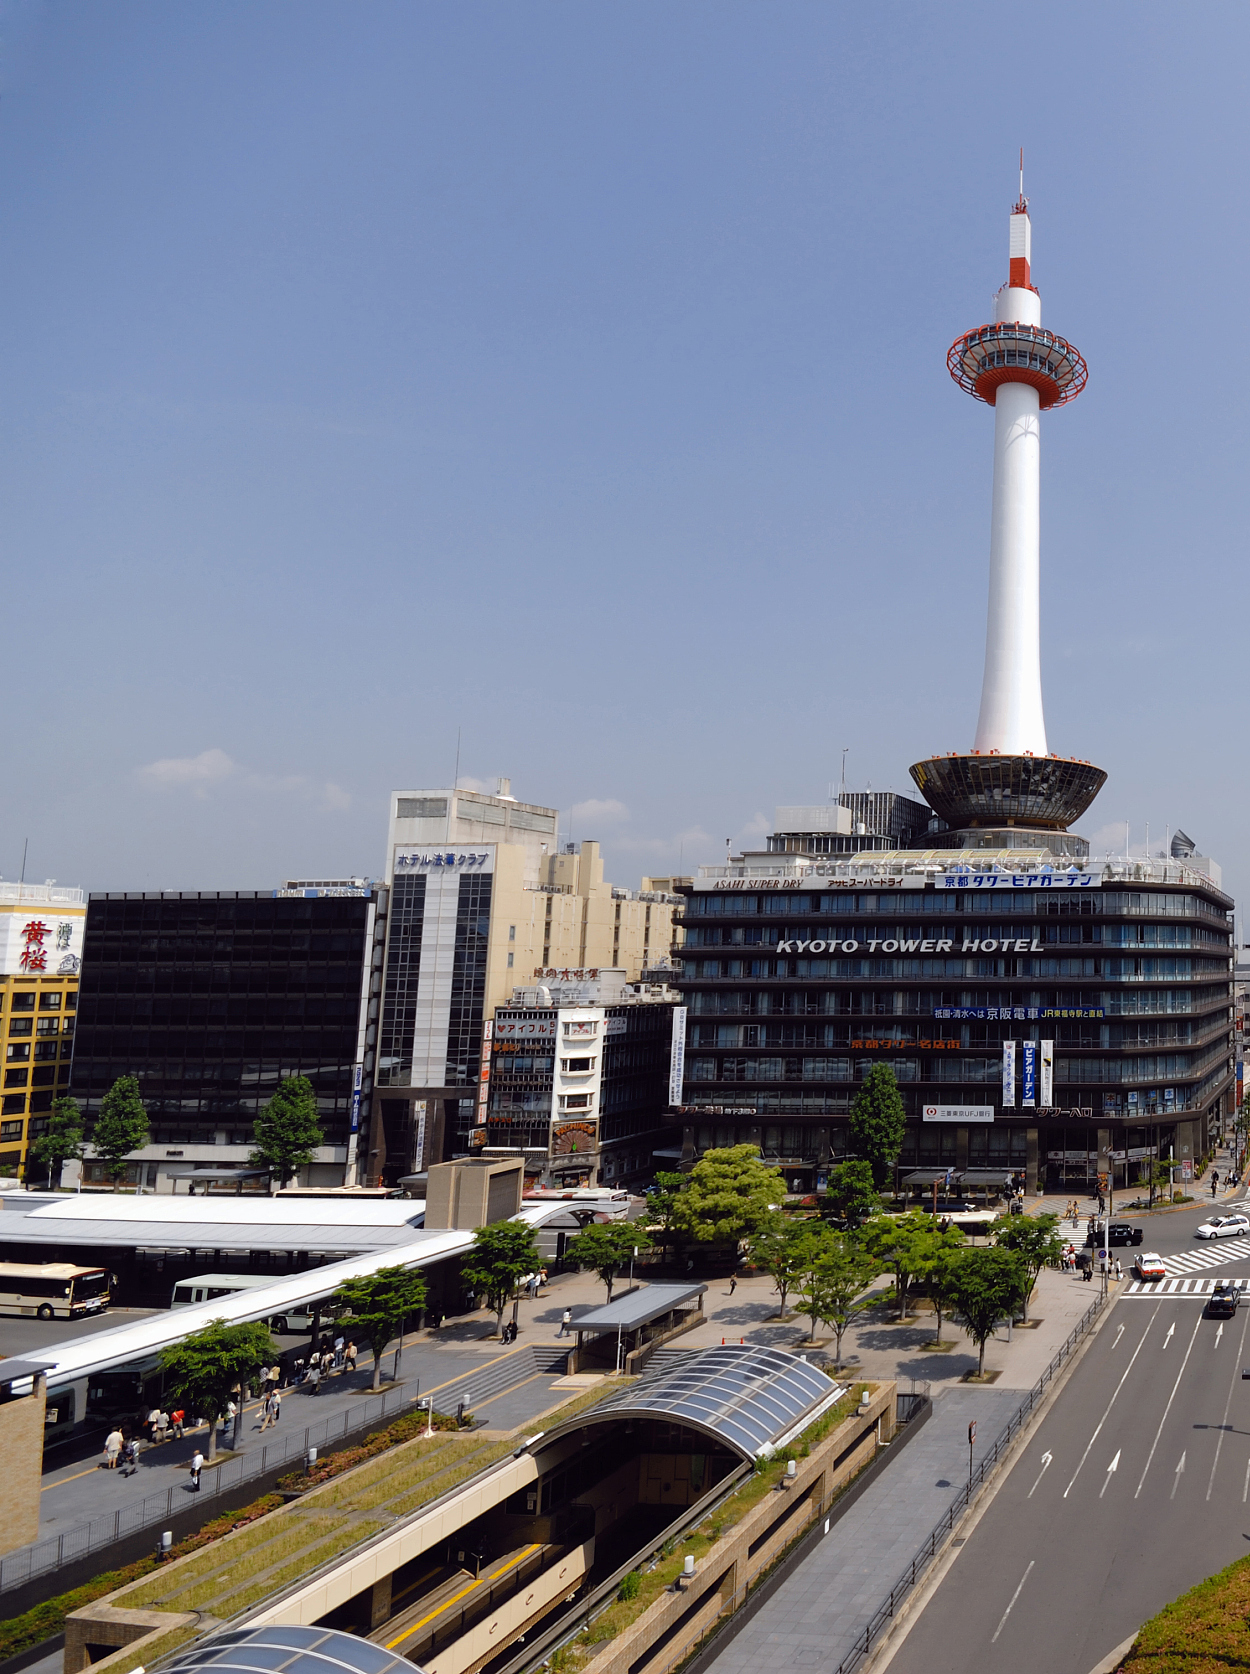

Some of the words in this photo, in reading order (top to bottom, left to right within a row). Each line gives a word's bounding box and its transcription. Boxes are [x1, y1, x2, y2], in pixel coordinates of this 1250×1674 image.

[398, 853, 490, 867] ホテル法華クラブ
[713, 880, 745, 889] ASAHI
[747, 880, 780, 889] SUPER
[782, 879, 804, 888] DRY
[827, 877, 904, 888] アサヒスーパードライ
[20, 921, 54, 972] 黄桜
[777, 940, 859, 953] KYOTO
[867, 939, 953, 952] TOWER
[961, 938, 1045, 952] HOTEL
[986, 1008, 1039, 1020] 京阪電車
[507, 1025, 547, 1033] アイフル
[851, 1040, 960, 1049] 京都タワー名店街
[1025, 1049, 1033, 1098] ビアガーデン
[940, 1110, 991, 1118] 三菱東京UFJ銀行
